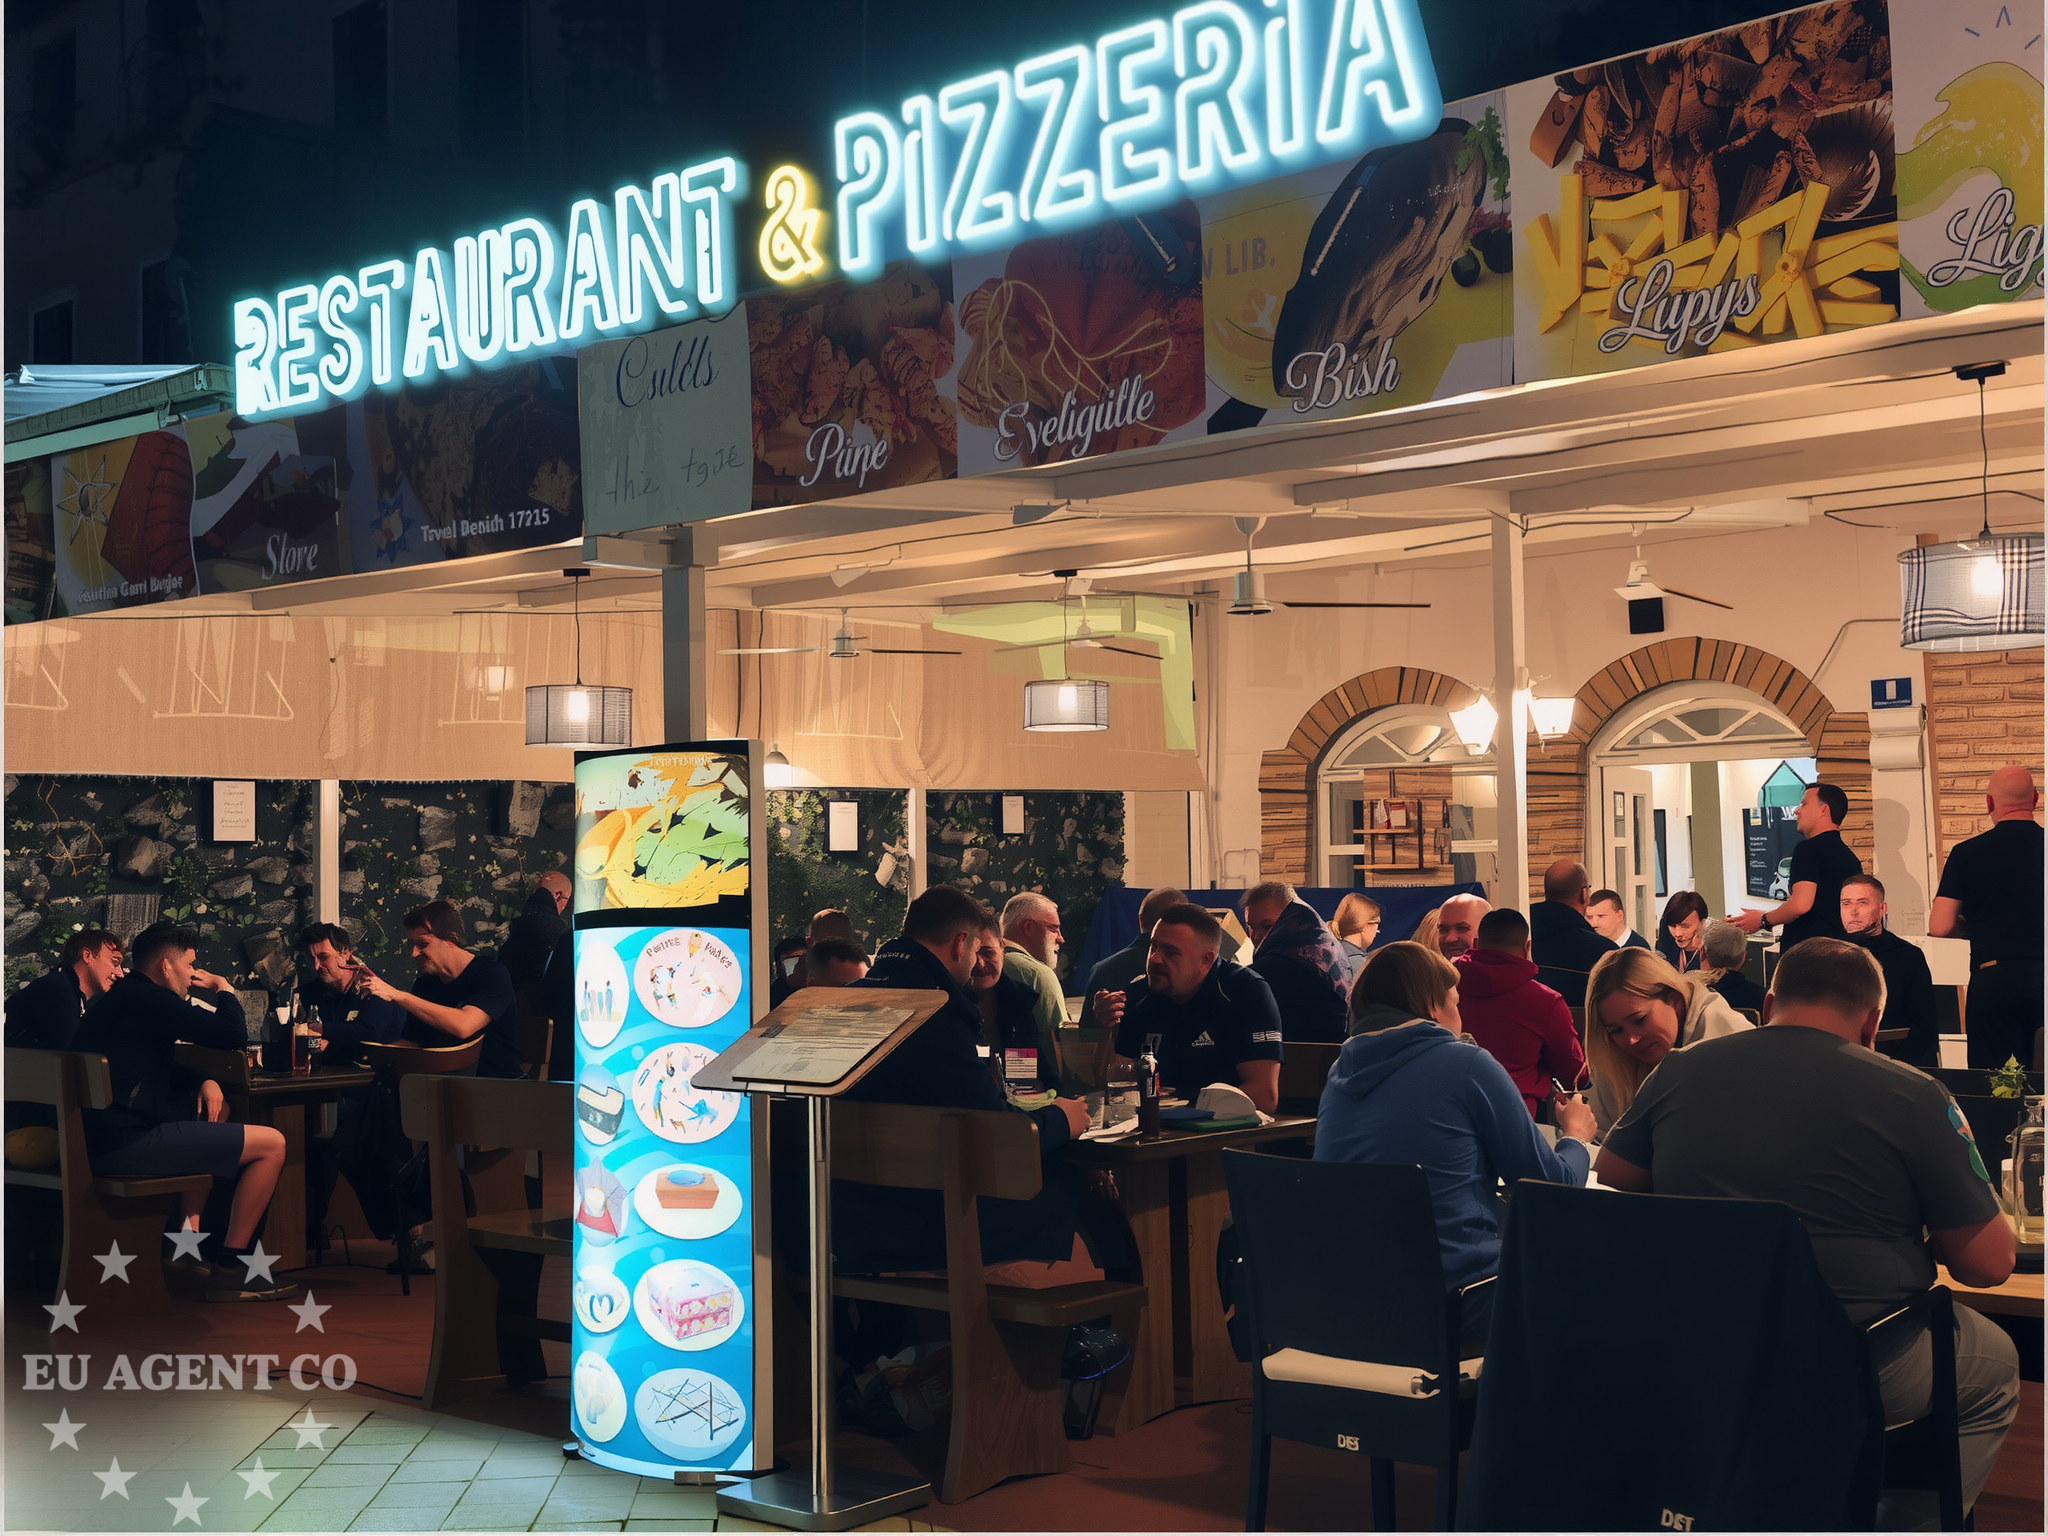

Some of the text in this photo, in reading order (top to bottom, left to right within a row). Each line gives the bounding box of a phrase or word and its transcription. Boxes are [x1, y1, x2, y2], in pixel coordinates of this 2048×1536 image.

[234, 156, 737, 418] RESTAURANT
[758, 164, 824, 282] &
[1285, 337, 1401, 413] Bish
